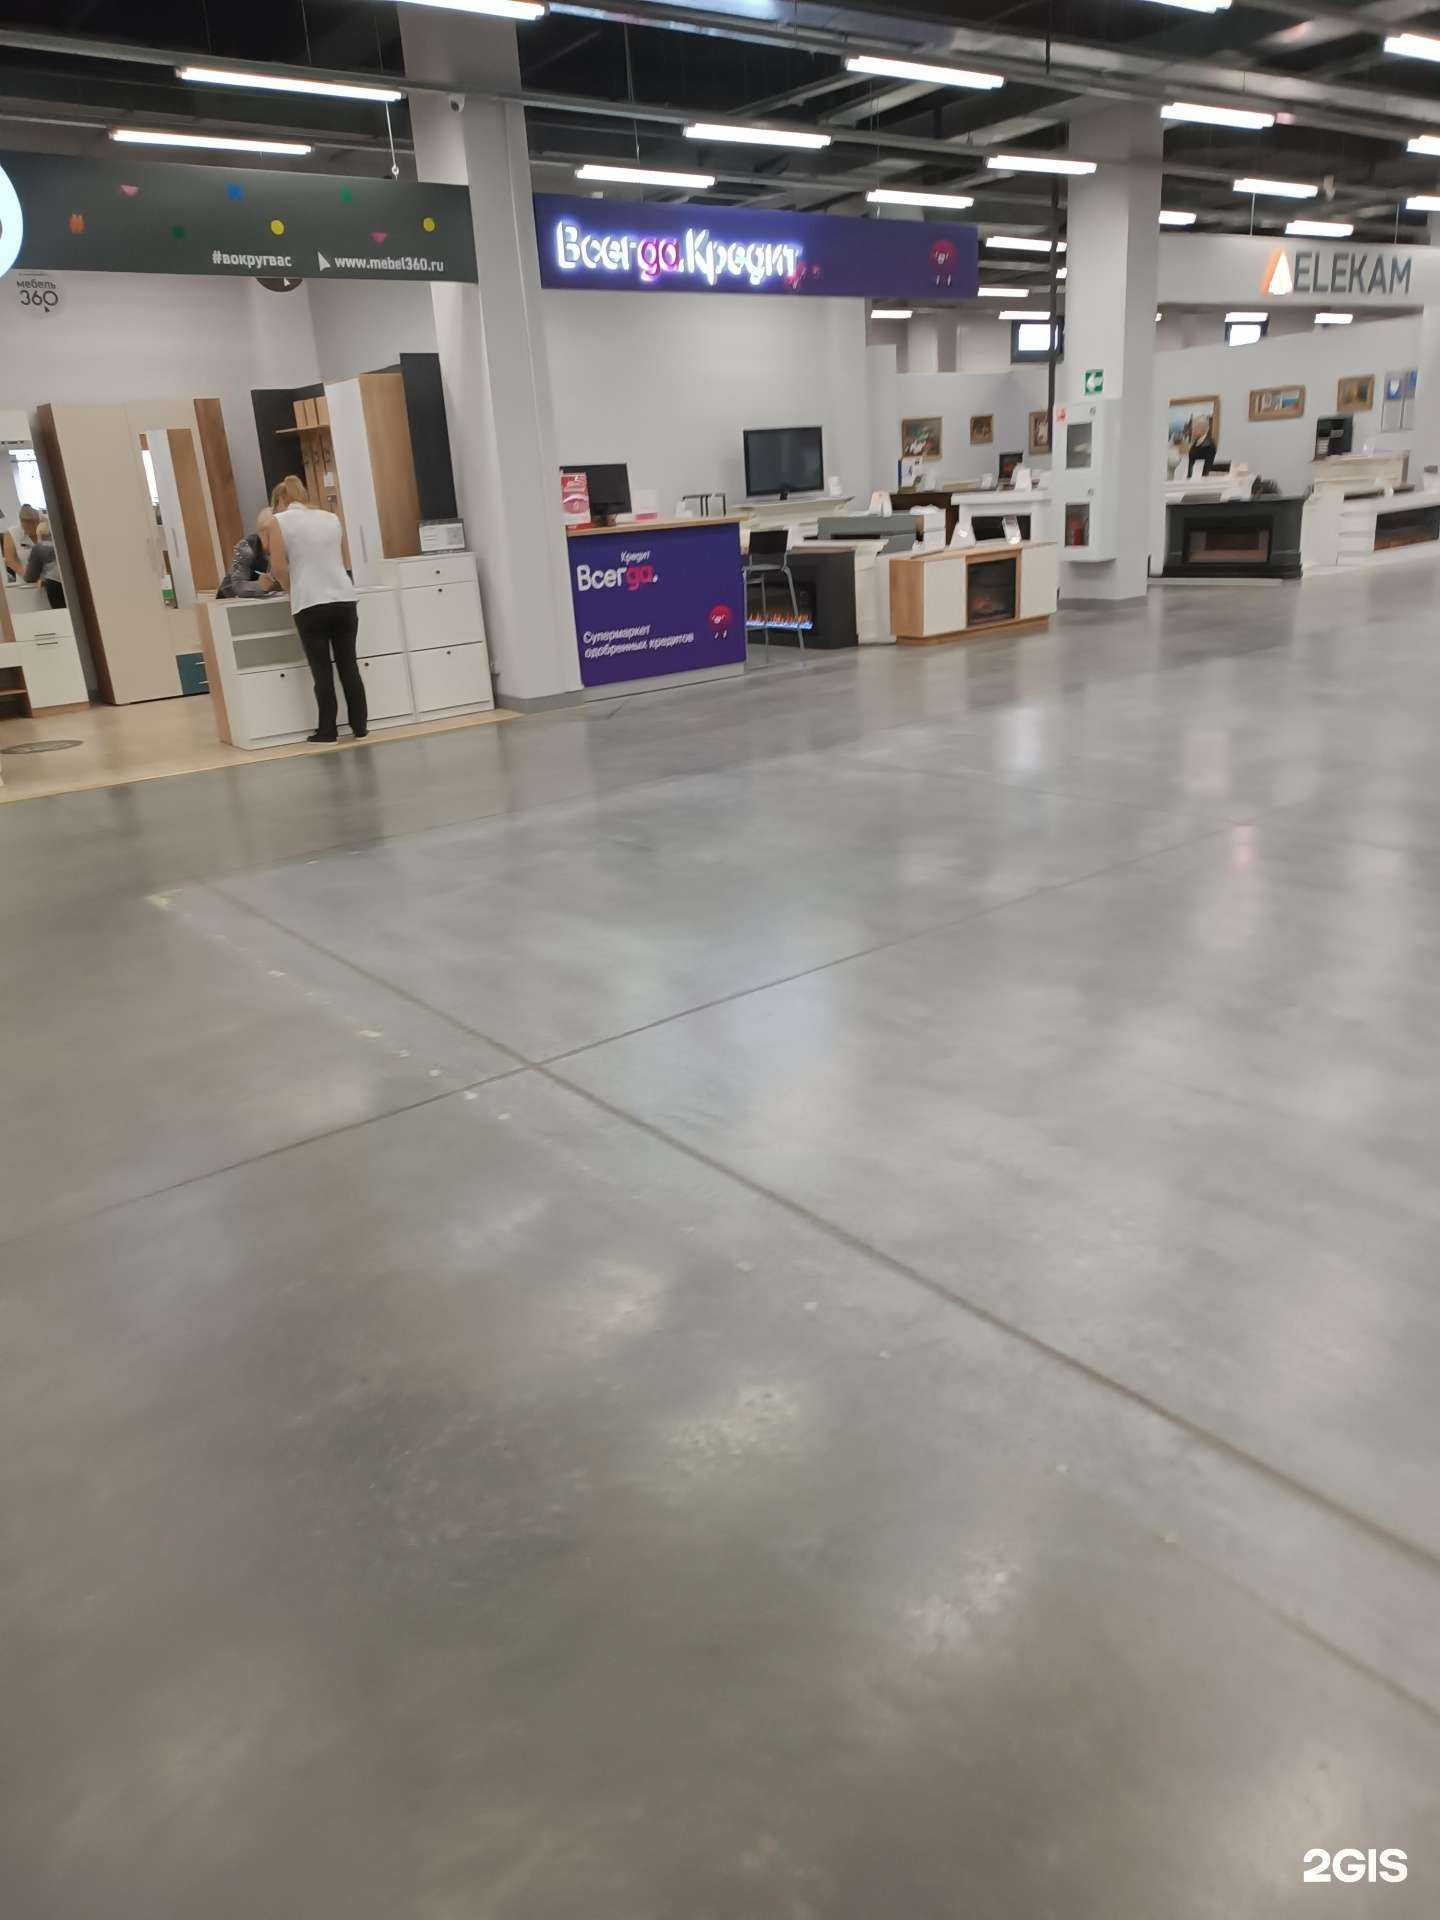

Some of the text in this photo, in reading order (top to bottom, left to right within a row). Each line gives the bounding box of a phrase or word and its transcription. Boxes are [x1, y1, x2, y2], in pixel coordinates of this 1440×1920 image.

[211, 250, 292, 268] #вокругвас
[334, 256, 444, 272] www.mebel360.ru
[1293, 251, 1412, 295] ELEKAM
[16, 279, 56, 289] мебель
[20, 289, 59, 306] 360
